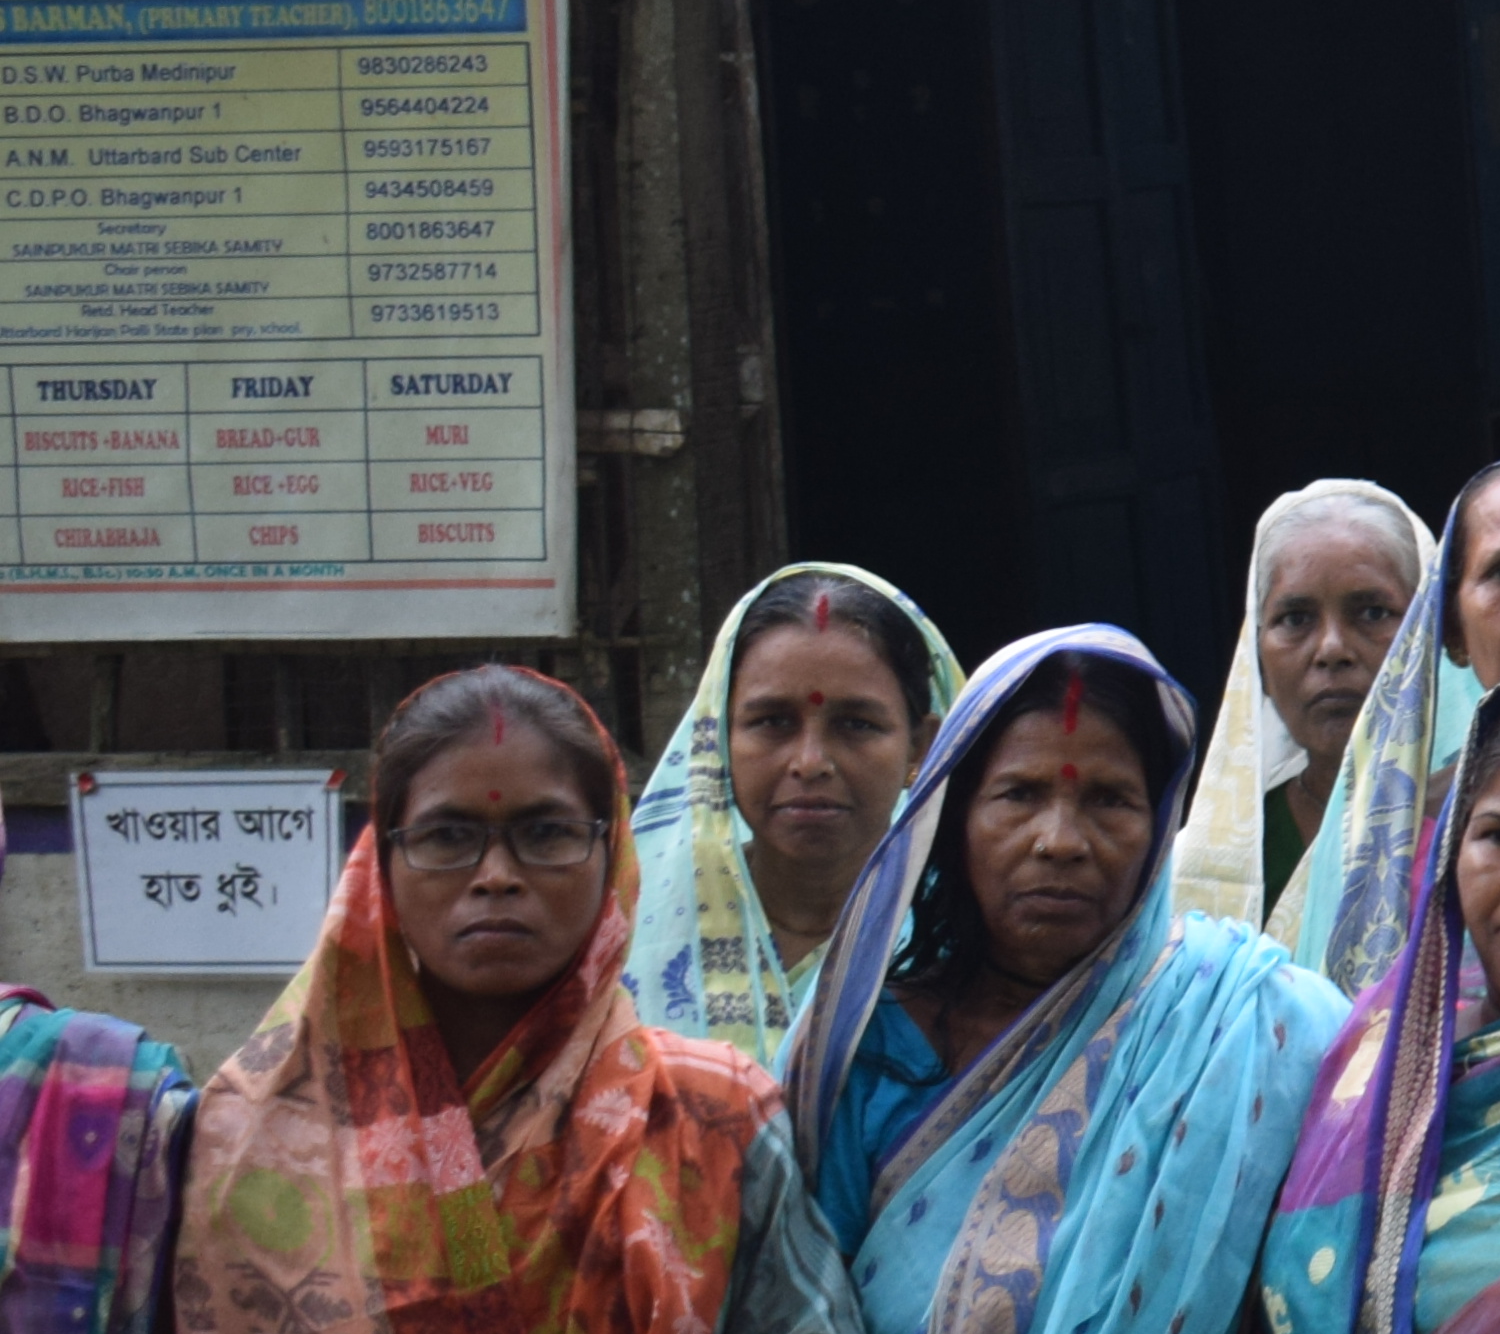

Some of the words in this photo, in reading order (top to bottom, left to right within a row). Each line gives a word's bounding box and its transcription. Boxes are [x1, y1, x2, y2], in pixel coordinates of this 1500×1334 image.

[11, 4, 132, 34] BARMAN,
[139, 5, 243, 34] (PRIMARY
[77, 64, 134, 83] Purba
[142, 62, 235, 83] Medinipur
[358, 55, 487, 74] 9830286243
[4, 105, 70, 123] B.D.O.
[80, 104, 204, 125] Bhagwanpur
[213, 103, 221, 118] 1
[361, 96, 489, 116] 9564404224
[7, 149, 73, 166] A.N.M.
[89, 147, 182, 165] Uttarbard
[189, 145, 228, 164] Sub
[235, 143, 301, 162] Center
[364, 137, 491, 158] 9593175167
[7, 188, 91, 208] C.D.P.O.
[101, 187, 225, 209] Bhagwanpur
[234, 187, 242, 203] 1
[366, 179, 493, 199] 9434508459
[12, 243, 105, 257] SAINPUKUR
[110, 242, 159, 255] MATRI
[224, 239, 283, 253] SAMITY
[367, 221, 495, 240] 8001863647
[97, 222, 166, 236] Secretary
[105, 264, 138, 276] Chair
[144, 265, 187, 278] person
[113, 283, 158, 296] MATRI
[216, 281, 269, 295] SAMITY
[368, 263, 497, 282] 9732587714
[120, 304, 157, 316] Head
[162, 303, 215, 316] Teacher
[371, 303, 499, 322] 9733619513
[37, 379, 157, 401] THURSDAY
[232, 376, 314, 398] FRIDAY
[391, 373, 512, 396] SATURDAY
[25, 430, 97, 451] BISCUITS
[426, 425, 469, 446] MURI
[233, 475, 273, 495] RICE
[250, 525, 298, 545] CHIPS
[418, 523, 494, 543] BISCUITS
[205, 565, 246, 577] ONCE
[273, 566, 285, 576] A
[290, 564, 345, 576] MONTH
[106, 807, 221, 842] খাওয়ার
[233, 807, 314, 842] আগে
[140, 870, 202, 908] হাত
